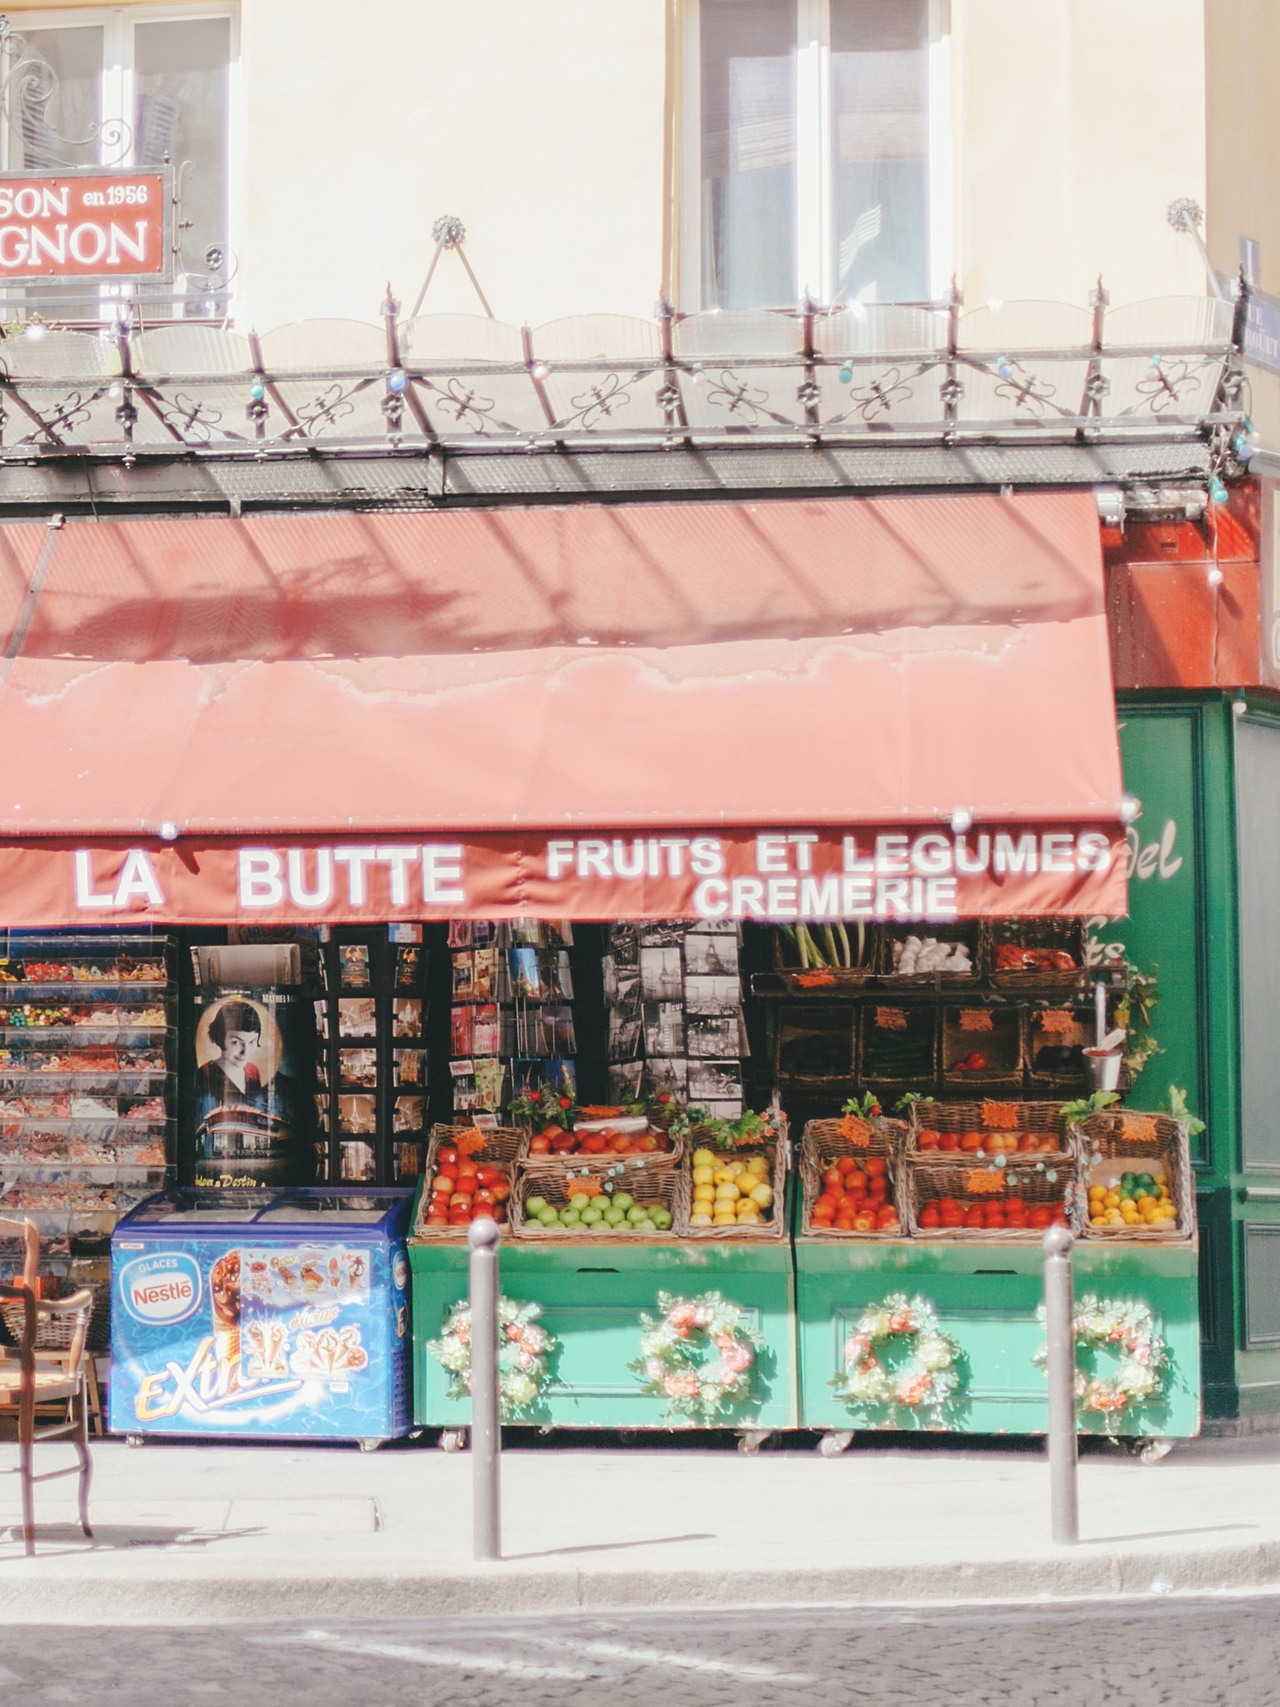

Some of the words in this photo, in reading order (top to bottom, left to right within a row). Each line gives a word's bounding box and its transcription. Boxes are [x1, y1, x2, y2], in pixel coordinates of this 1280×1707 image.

[83, 190, 105, 206] en
[106, 185, 148, 204] 1956
[547, 837, 722, 877] FRUITS
[756, 834, 818, 872] ET
[842, 832, 1111, 873] LEGUMES
[76, 849, 164, 907] LA
[238, 845, 464, 906] BUTTE
[694, 877, 958, 916] CREMERIE
[220, 1174, 257, 1187] Destin
[138, 1258, 178, 1273] GLACES
[133, 1280, 192, 1306] Nestlé
